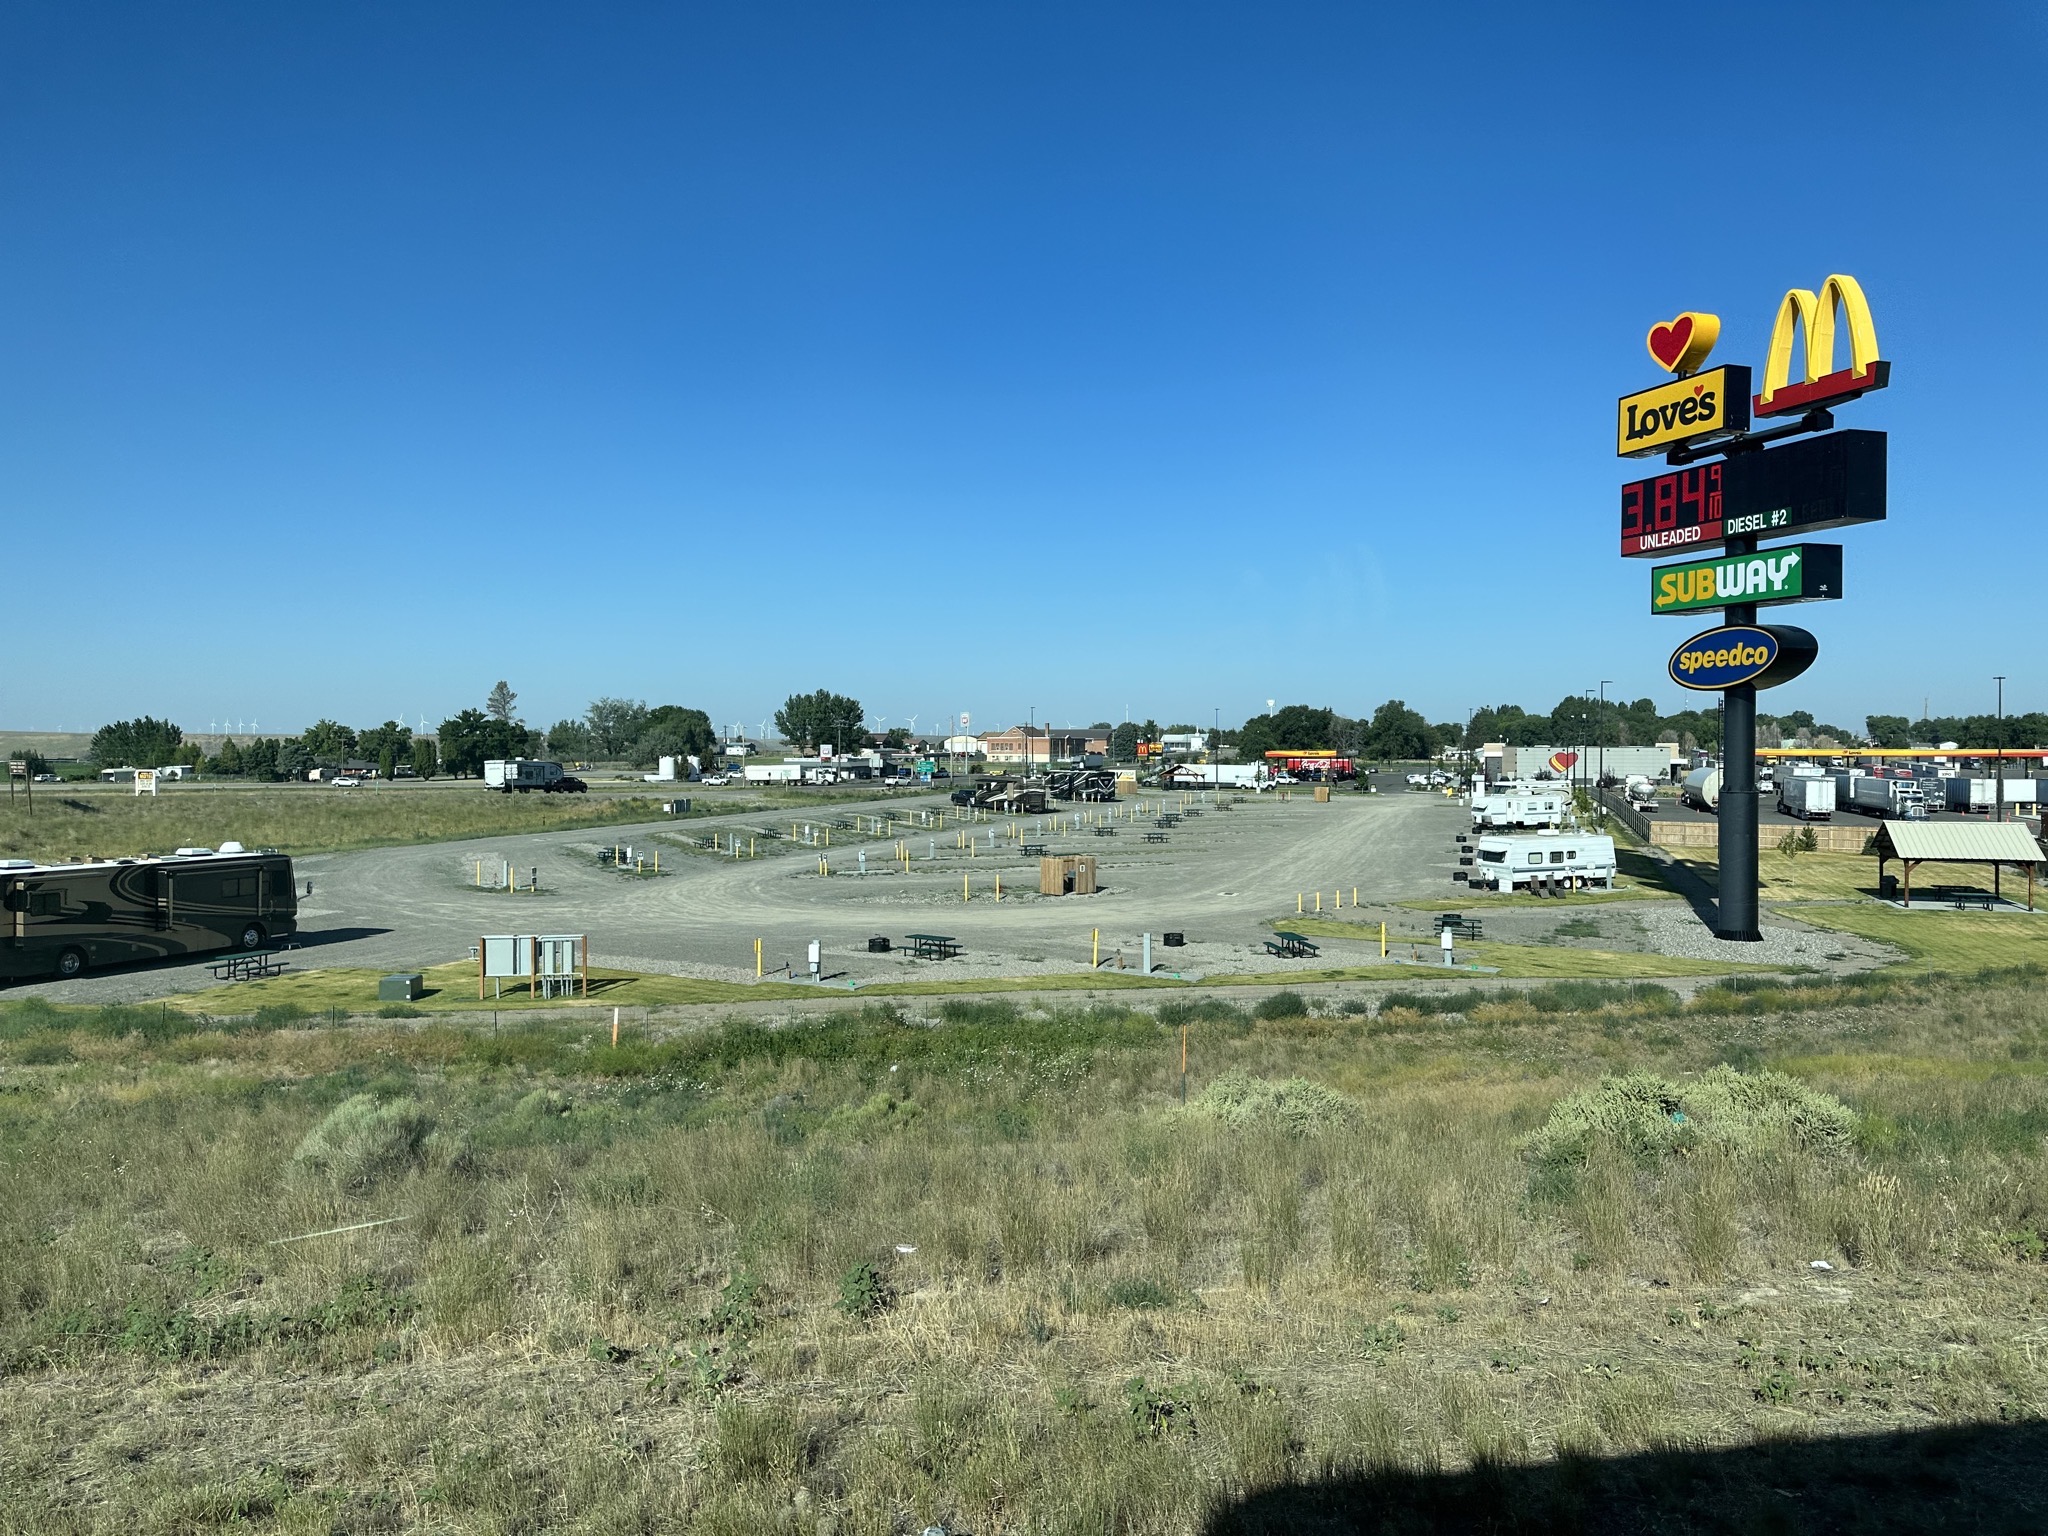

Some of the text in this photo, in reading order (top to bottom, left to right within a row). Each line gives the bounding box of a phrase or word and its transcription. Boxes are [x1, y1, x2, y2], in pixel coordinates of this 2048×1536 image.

[1728, 509, 1787, 534] DIESEL #2
[1640, 526, 1700, 550] UNLEADED
[1655, 551, 1800, 607] SUBWAY
[1679, 642, 1768, 674] speedco
